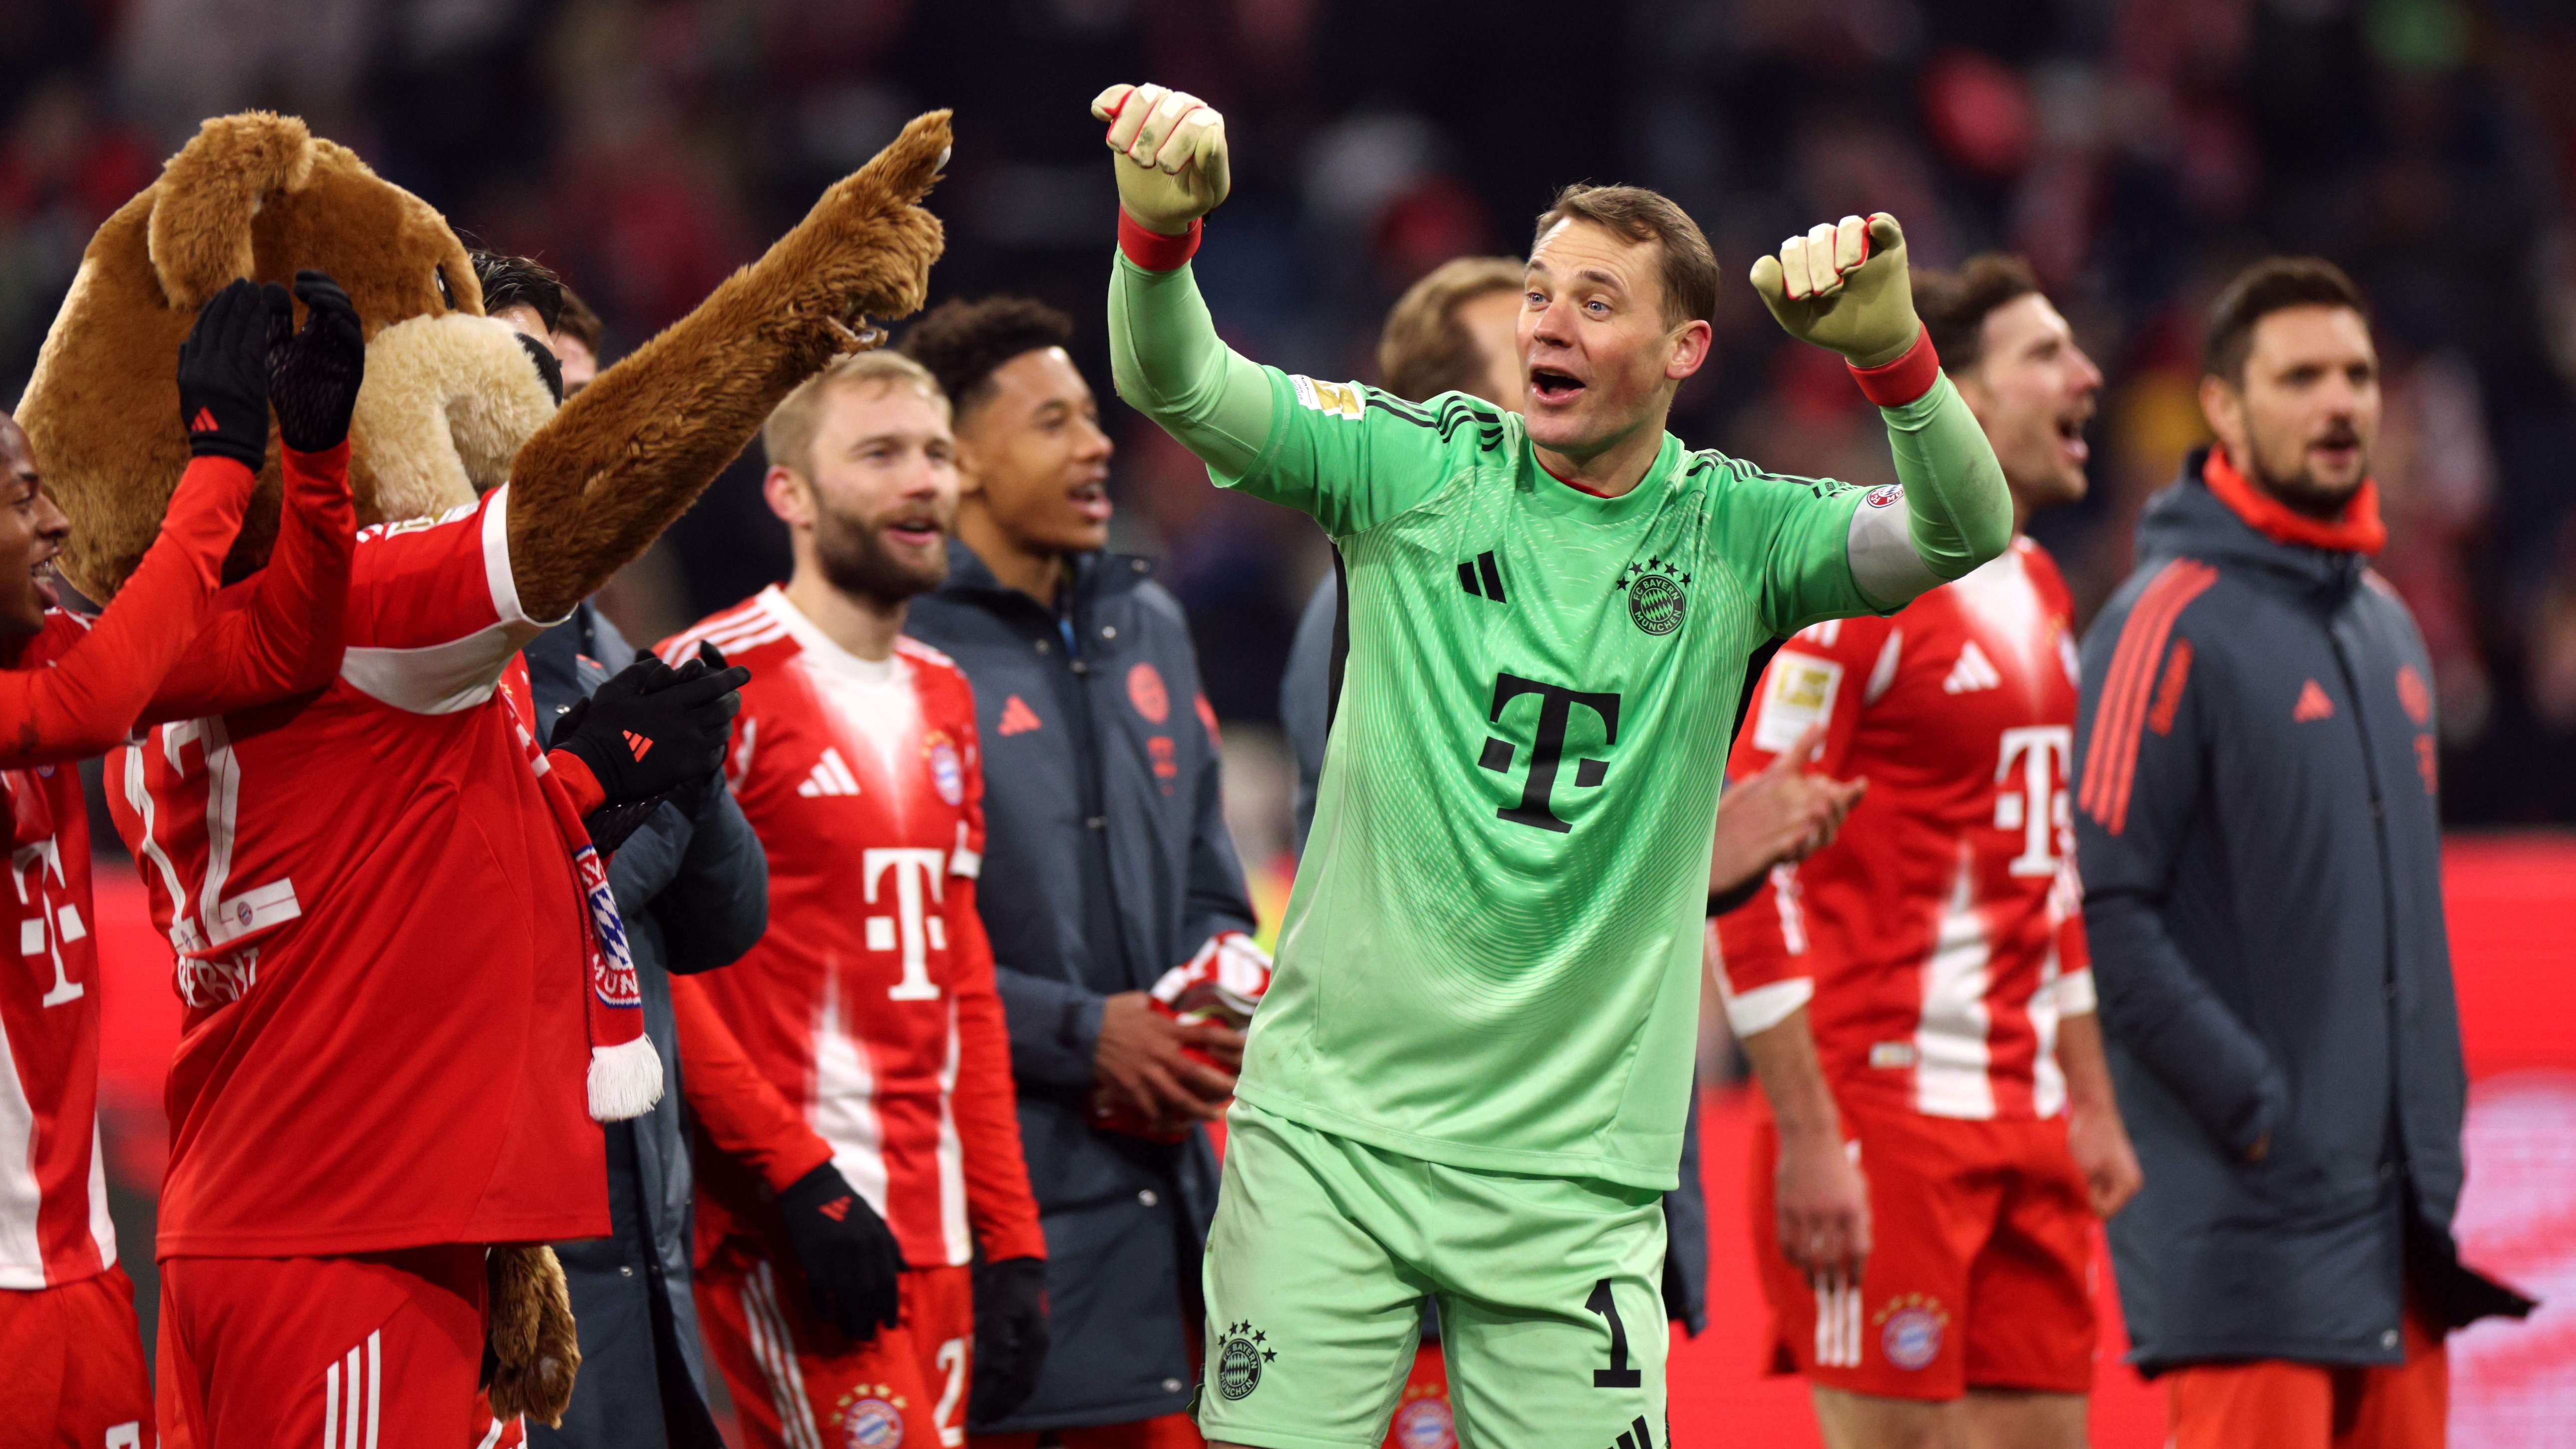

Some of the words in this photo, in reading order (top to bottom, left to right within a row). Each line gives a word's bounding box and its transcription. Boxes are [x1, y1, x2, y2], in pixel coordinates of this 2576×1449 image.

[1633, 587, 1643, 601] FC
[1643, 579, 1680, 600] BAYERN
[1477, 673, 1621, 833] T
[1994, 725, 2072, 877] T
[12, 832, 86, 1008] T
[863, 848, 947, 1001] T
[1233, 1343, 1258, 1370] BAYERN
[1585, 1278, 1642, 1389] 1
